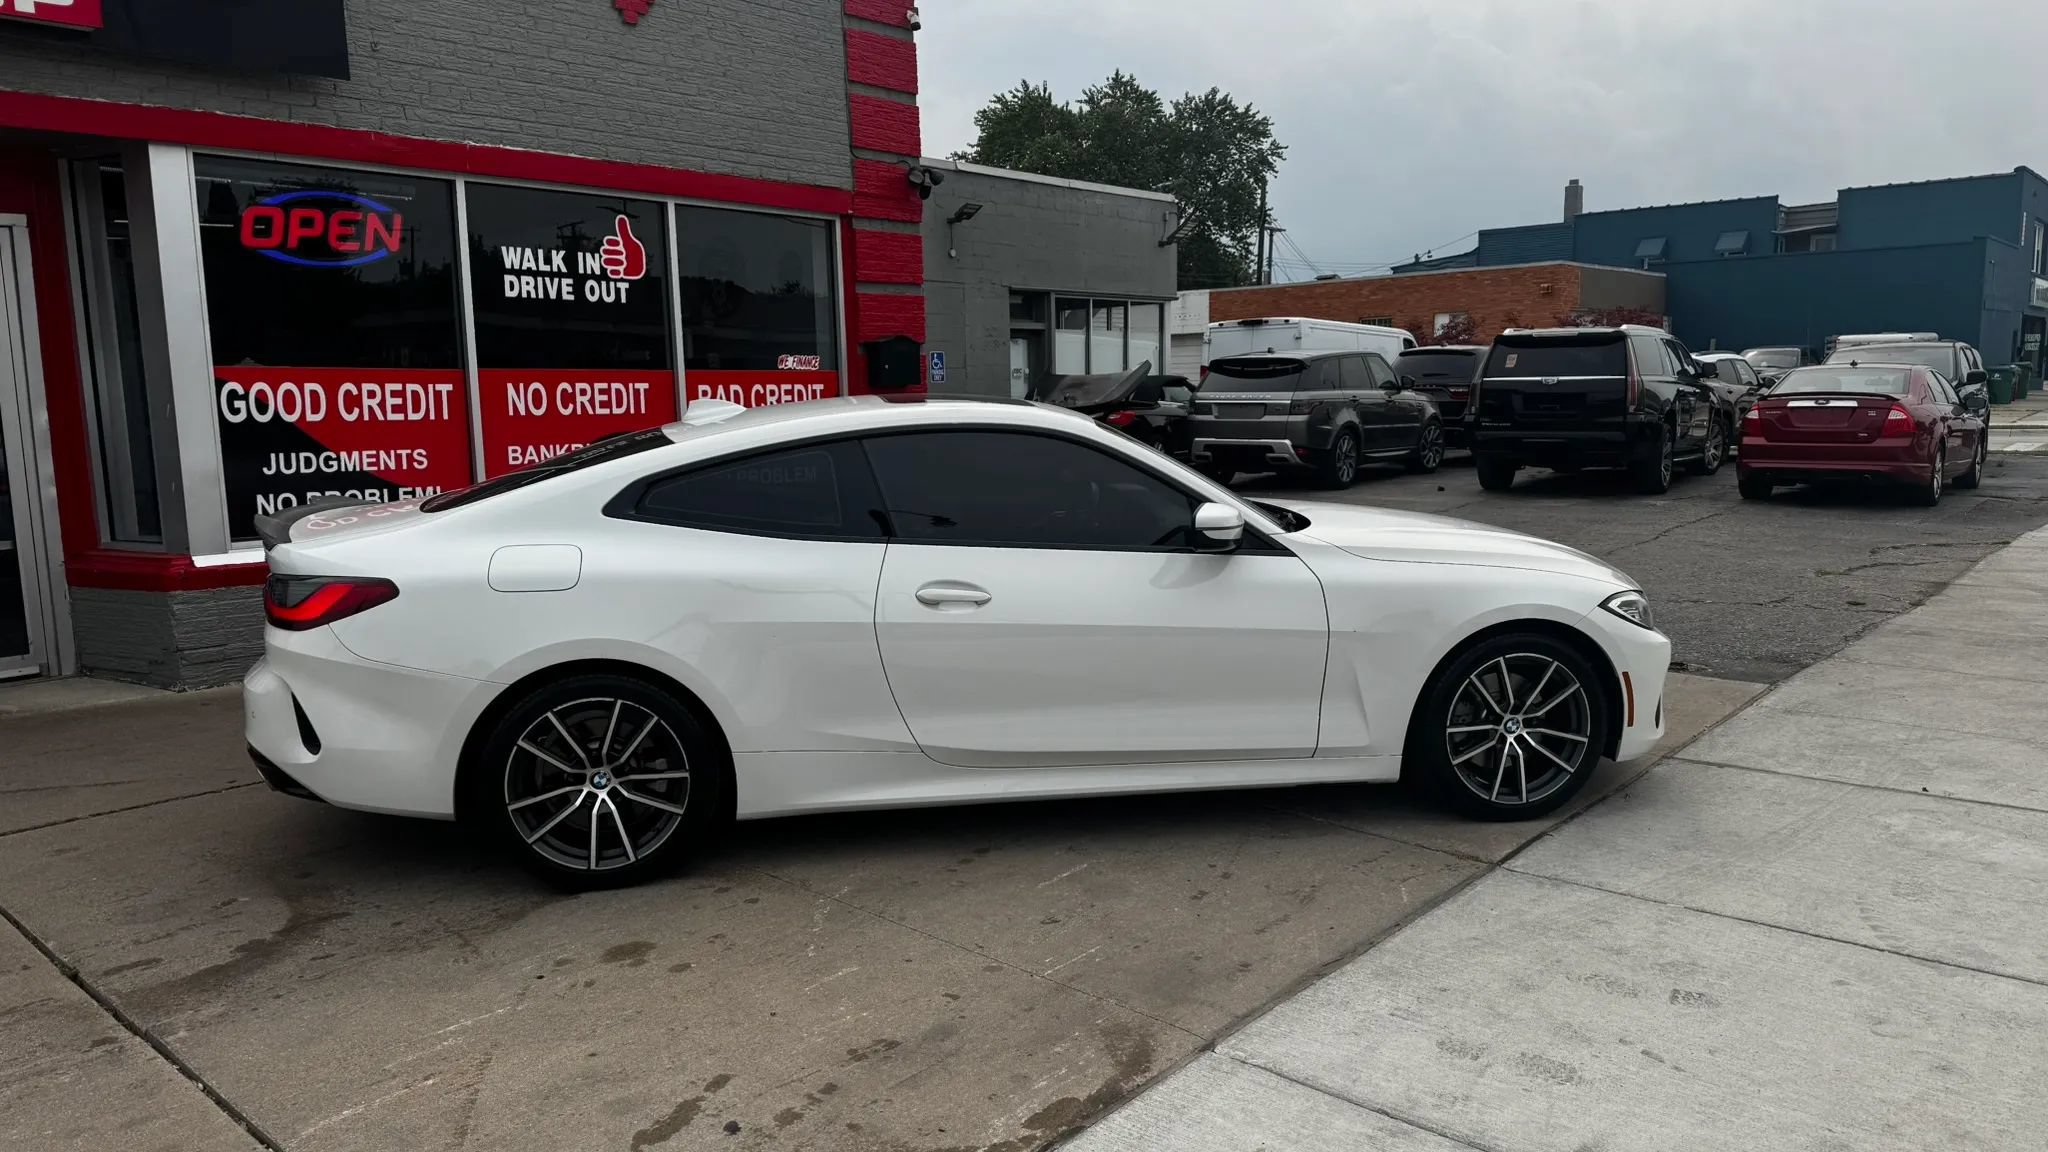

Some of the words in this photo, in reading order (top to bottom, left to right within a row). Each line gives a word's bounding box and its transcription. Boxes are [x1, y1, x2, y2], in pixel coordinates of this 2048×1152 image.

[239, 204, 403, 253] OPEN
[501, 245, 568, 274] WALK
[578, 251, 600, 275] IN
[504, 274, 574, 301] DRIVE
[584, 279, 630, 303] OUT
[220, 381, 327, 423] GOOD
[337, 382, 453, 422] CREDIT
[506, 382, 547, 416] NO
[556, 382, 649, 416] CREDIT
[262, 448, 429, 475] JUDGMENTS
[256, 491, 297, 516] NO
